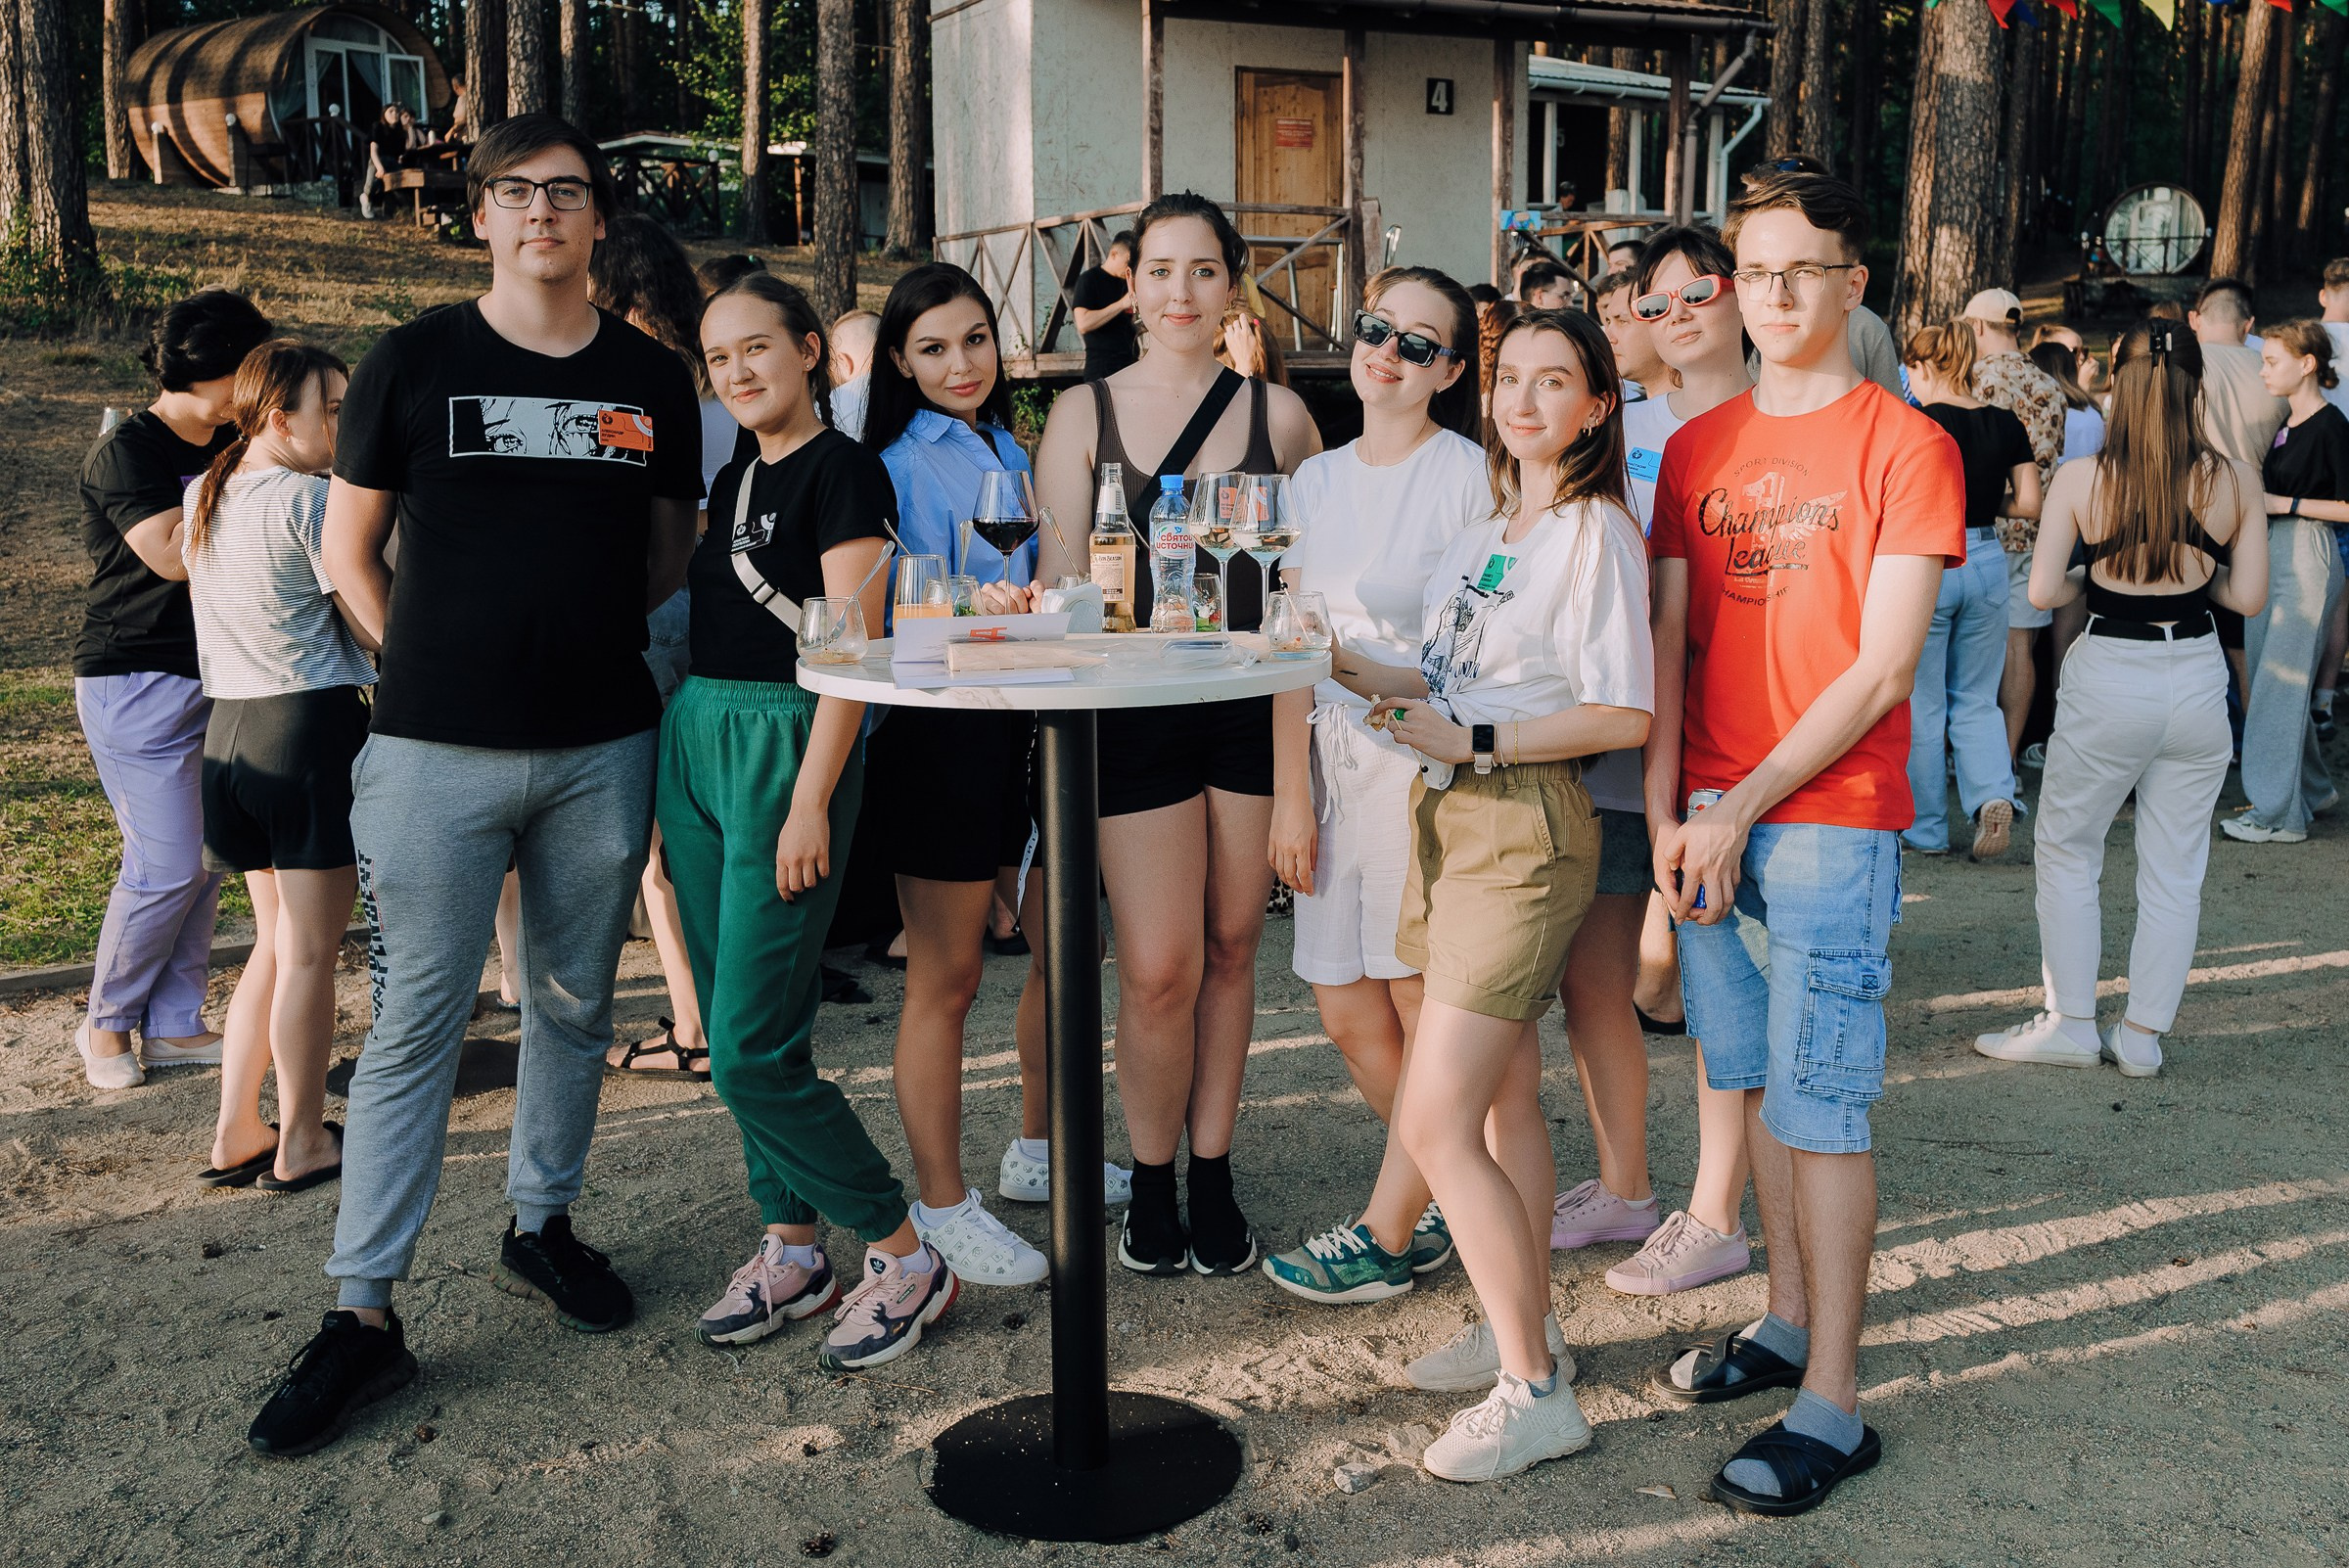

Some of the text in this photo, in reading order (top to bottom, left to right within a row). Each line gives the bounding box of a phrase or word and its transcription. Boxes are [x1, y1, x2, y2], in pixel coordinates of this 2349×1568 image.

[1431, 80, 1448, 113] 4
[1772, 457, 1809, 477] DIVISION
[1698, 487, 1840, 543] Champions
